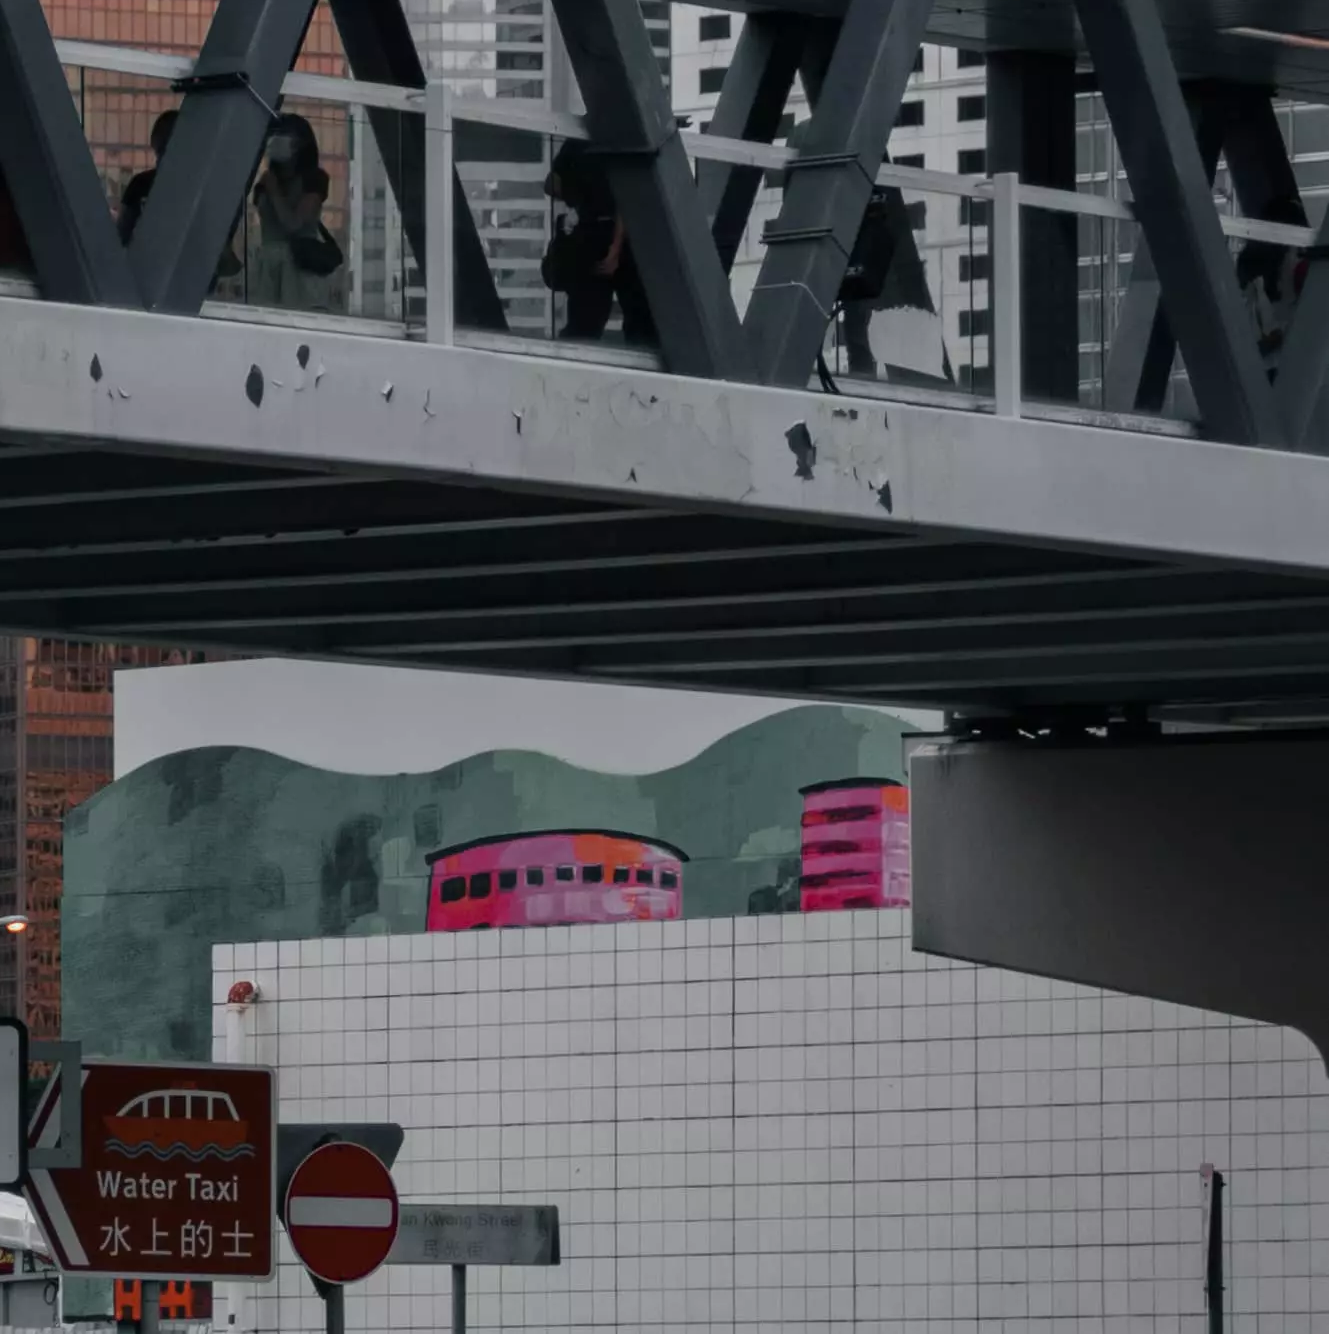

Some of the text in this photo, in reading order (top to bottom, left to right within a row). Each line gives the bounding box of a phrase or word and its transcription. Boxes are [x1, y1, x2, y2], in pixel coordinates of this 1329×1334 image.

[96, 1170, 239, 1202] Water Taxi
[99, 1216, 254, 1260] 水上的士
